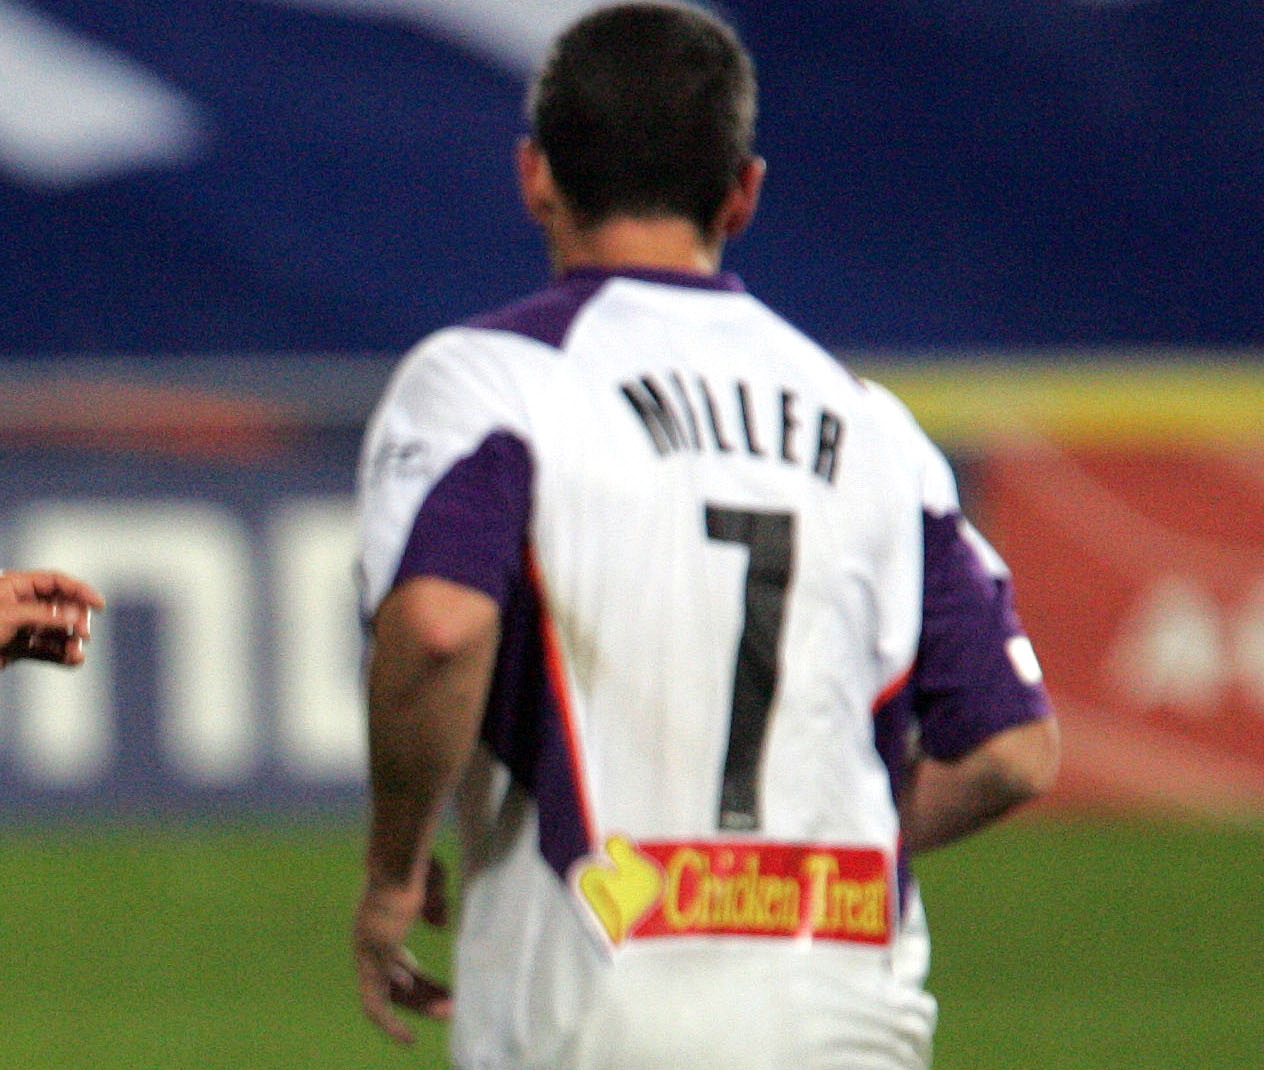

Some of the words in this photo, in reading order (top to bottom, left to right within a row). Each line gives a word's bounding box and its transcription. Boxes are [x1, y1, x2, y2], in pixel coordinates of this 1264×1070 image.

[618, 369, 845, 484] MILLER
[703, 504, 796, 830] 7
[664, 848, 800, 930] Chicken
[802, 854, 887, 935] Treat
